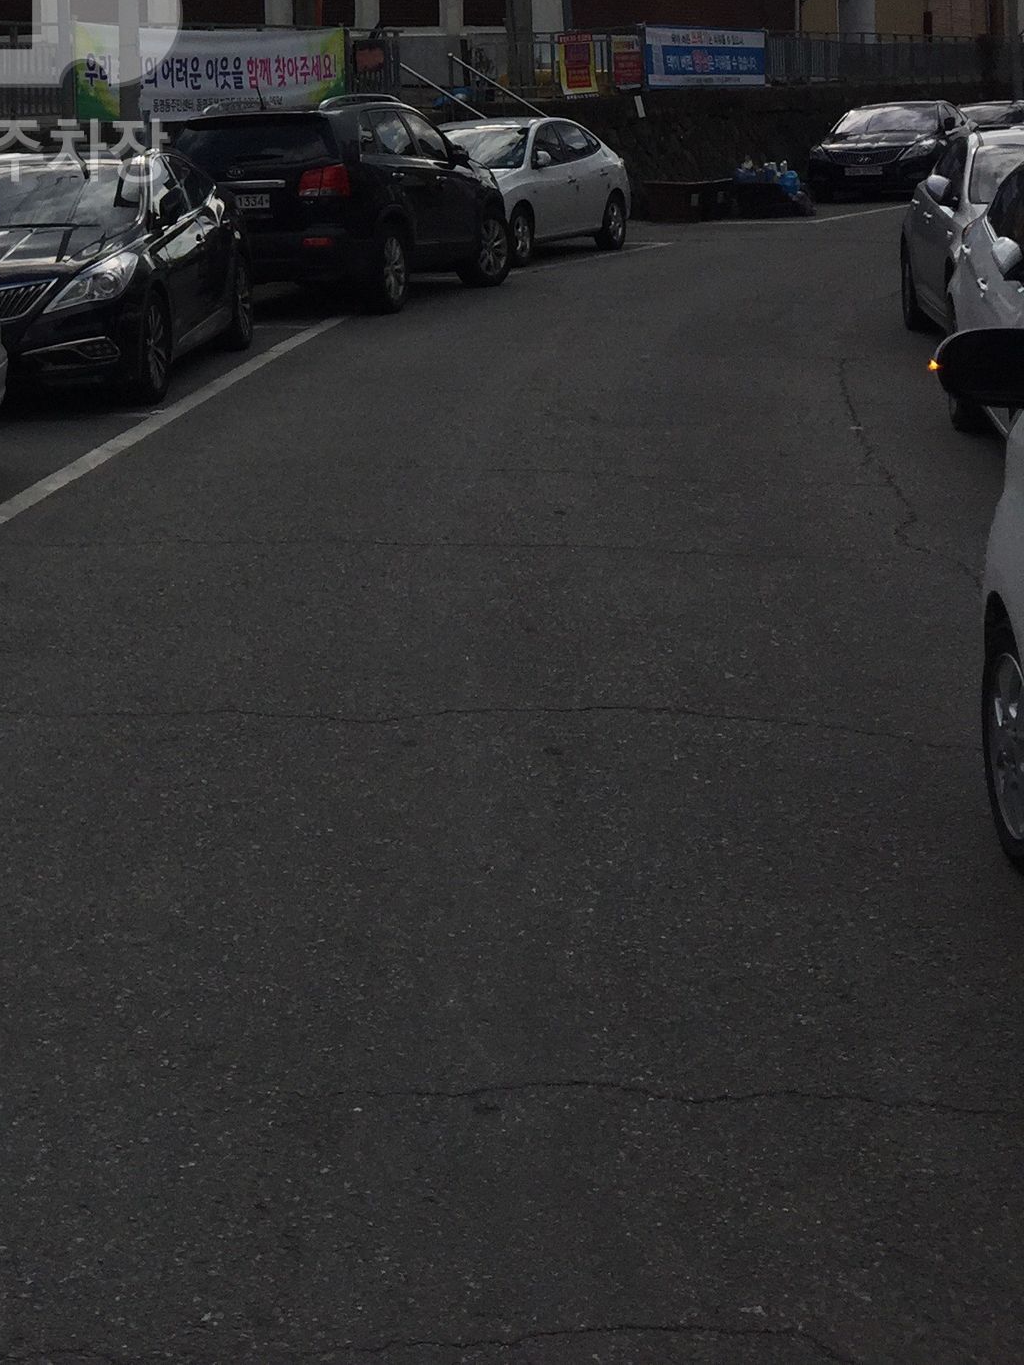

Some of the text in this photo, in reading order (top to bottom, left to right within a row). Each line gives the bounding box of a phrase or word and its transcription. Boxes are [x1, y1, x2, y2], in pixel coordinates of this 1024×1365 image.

[84, 53, 112, 88] 우리
[160, 56, 202, 90] 어려운
[205, 57, 245, 90] 이웃을
[246, 56, 272, 90] 함께
[274, 54, 337, 88] 찾아주세요!
